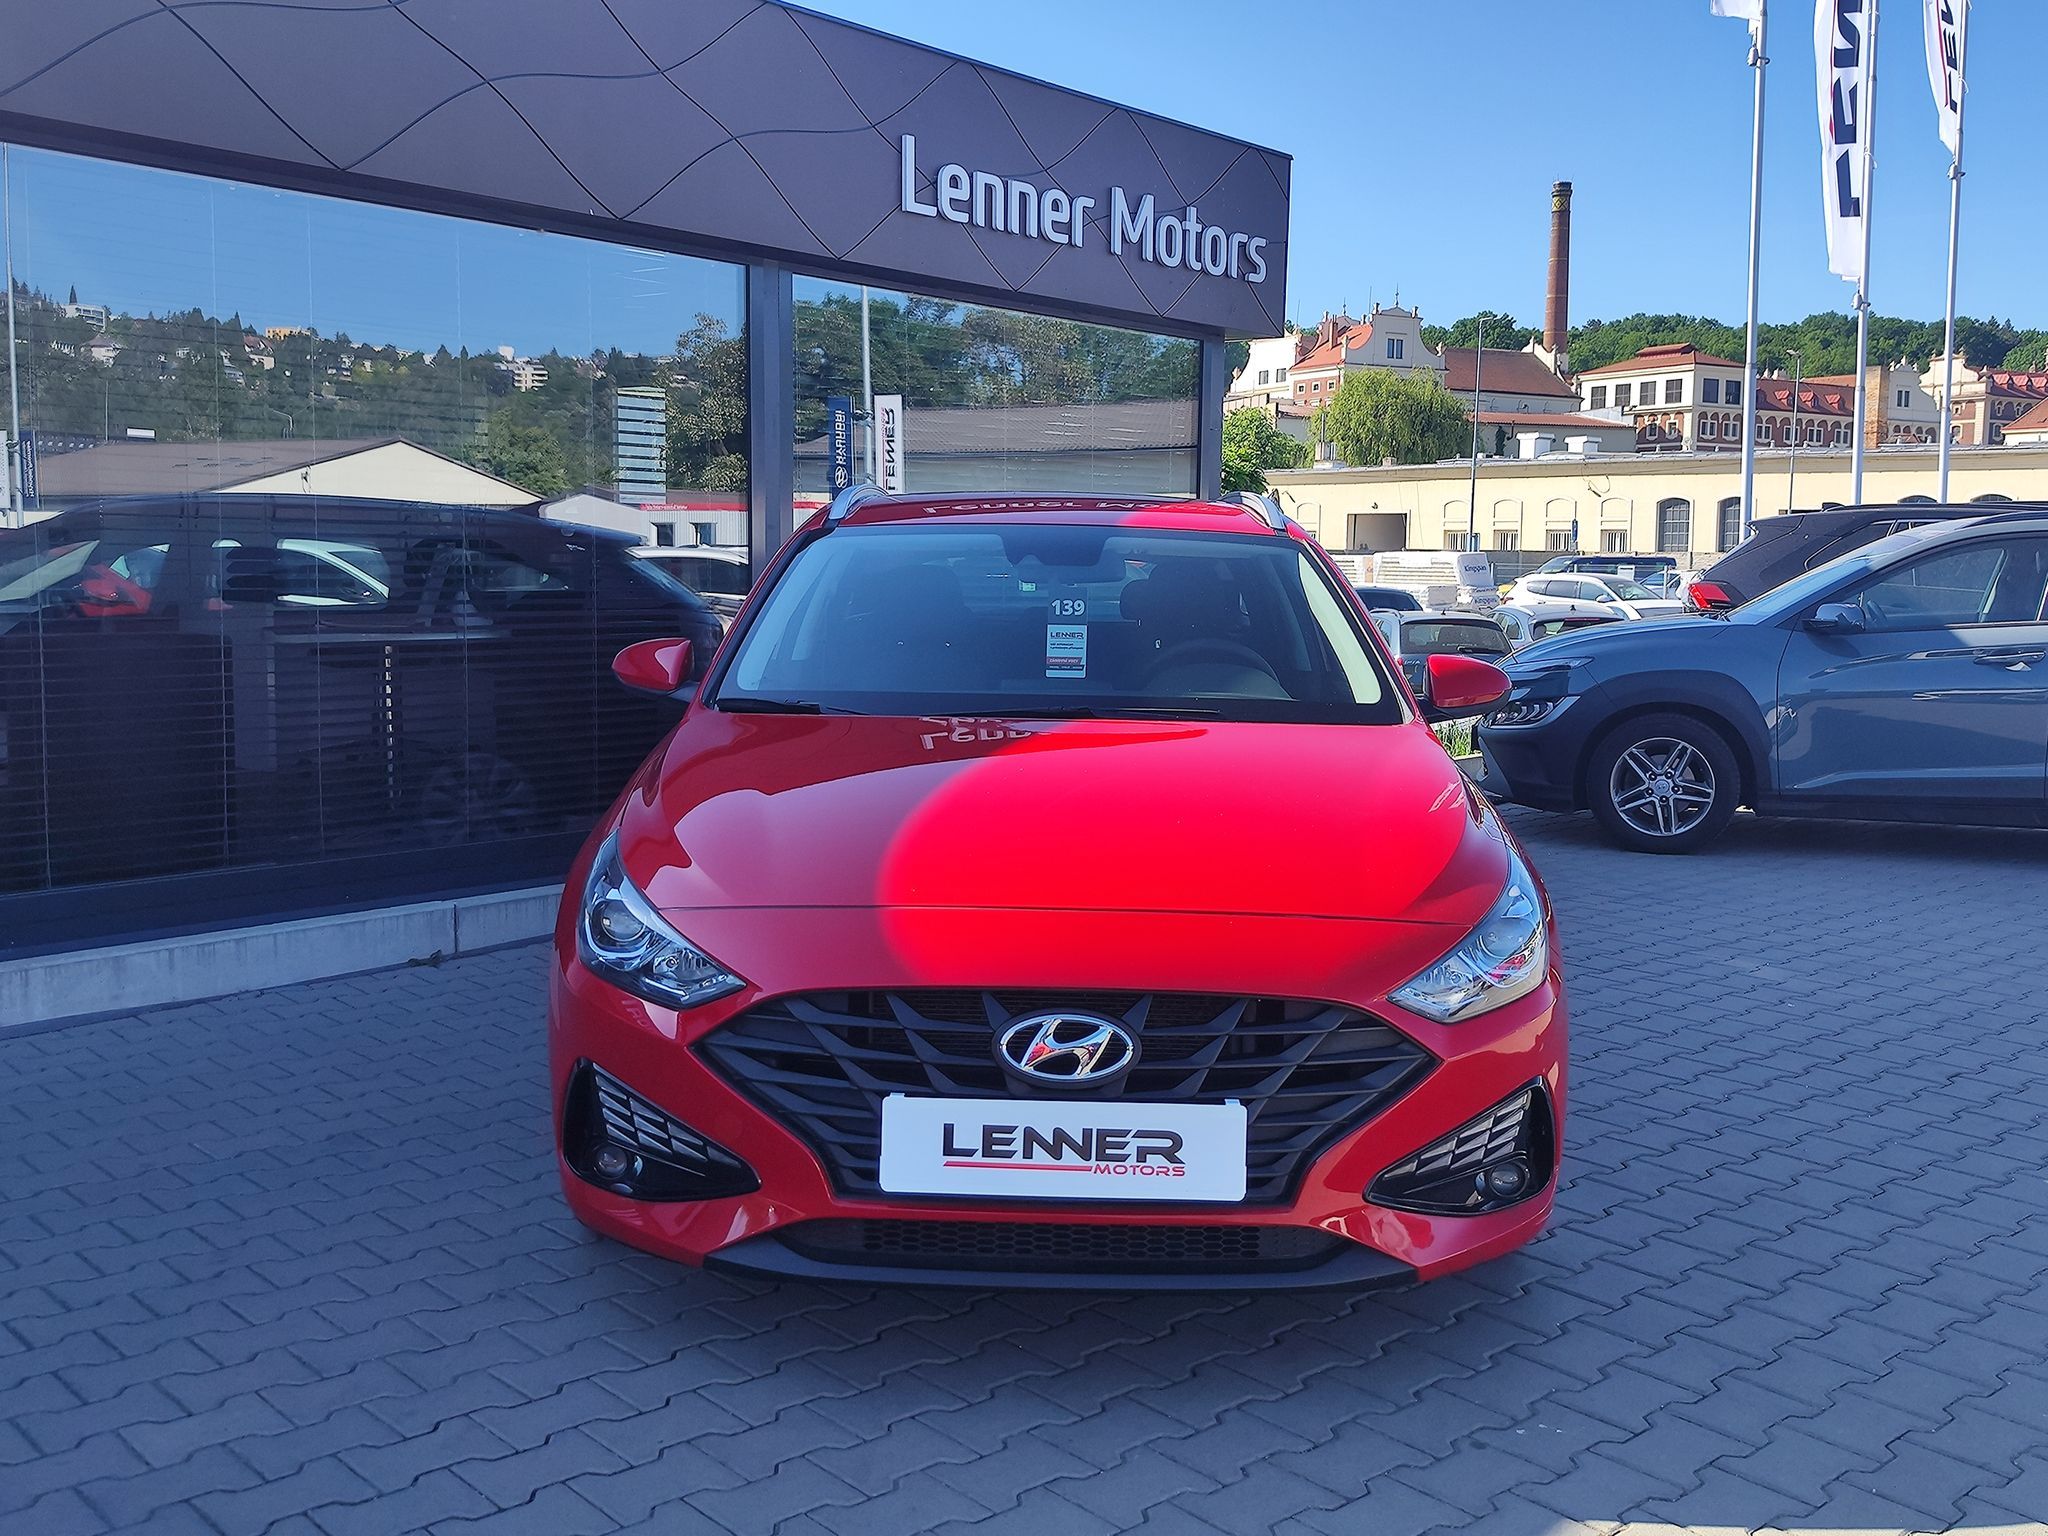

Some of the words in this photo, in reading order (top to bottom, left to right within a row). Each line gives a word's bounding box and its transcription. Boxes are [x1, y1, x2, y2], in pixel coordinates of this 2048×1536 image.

[901, 134, 1096, 248] Lenner
[1111, 186, 1268, 284] Motors
[1051, 599, 1086, 616] 139
[1050, 631, 1084, 639] LENNER
[942, 1122, 1186, 1164] LENNER
[1093, 1164, 1186, 1177] MOTORS
